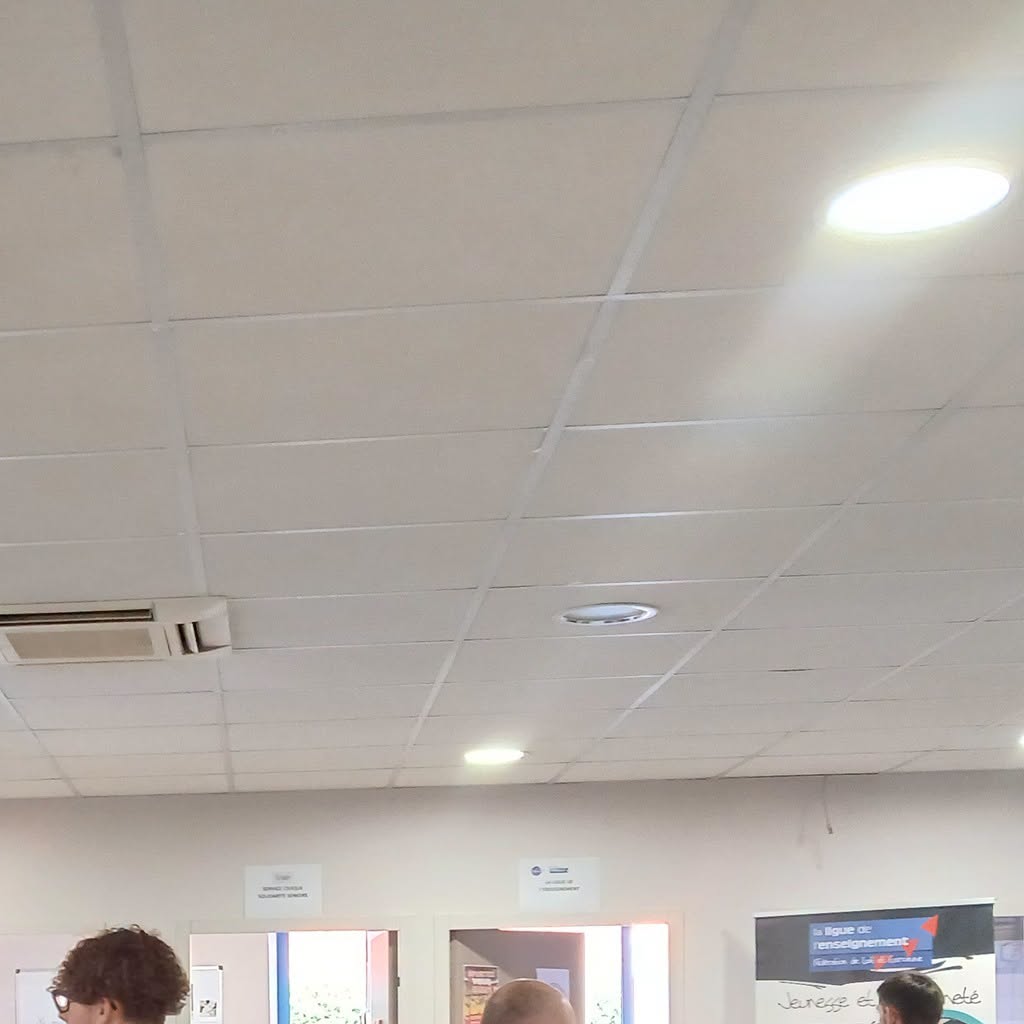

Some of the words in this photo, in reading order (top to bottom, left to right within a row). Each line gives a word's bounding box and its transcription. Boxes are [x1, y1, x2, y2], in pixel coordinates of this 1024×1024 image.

[824, 926, 855, 937] ligue
[856, 925, 873, 934] de
[777, 992, 850, 1012] Jeunesse
